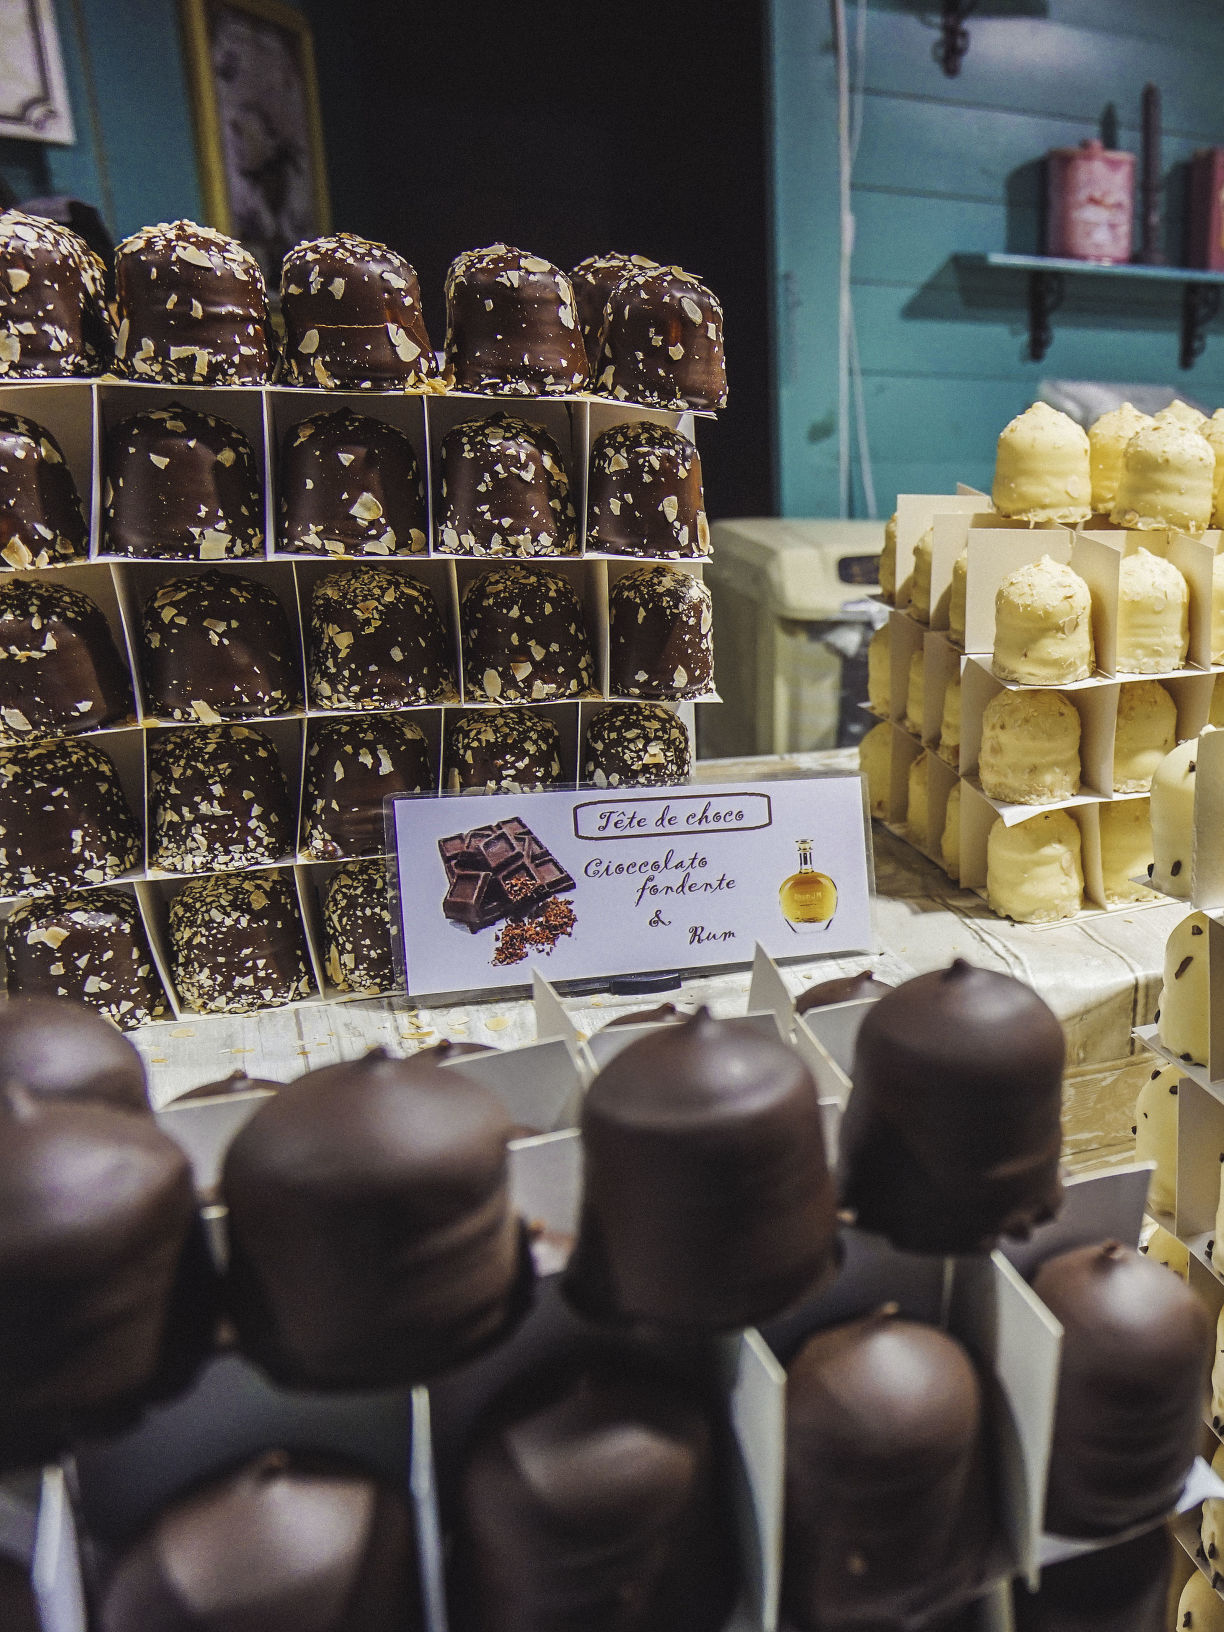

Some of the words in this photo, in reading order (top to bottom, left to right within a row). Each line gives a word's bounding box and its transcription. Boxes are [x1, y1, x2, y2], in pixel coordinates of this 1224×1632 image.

[597, 810, 648, 832] Tête
[655, 804, 678, 828] de
[685, 801, 744, 826] choco
[584, 848, 708, 878] Cioccolato
[635, 871, 737, 907] fondente
[648, 909, 672, 928] &
[688, 925, 736, 945] Rum
